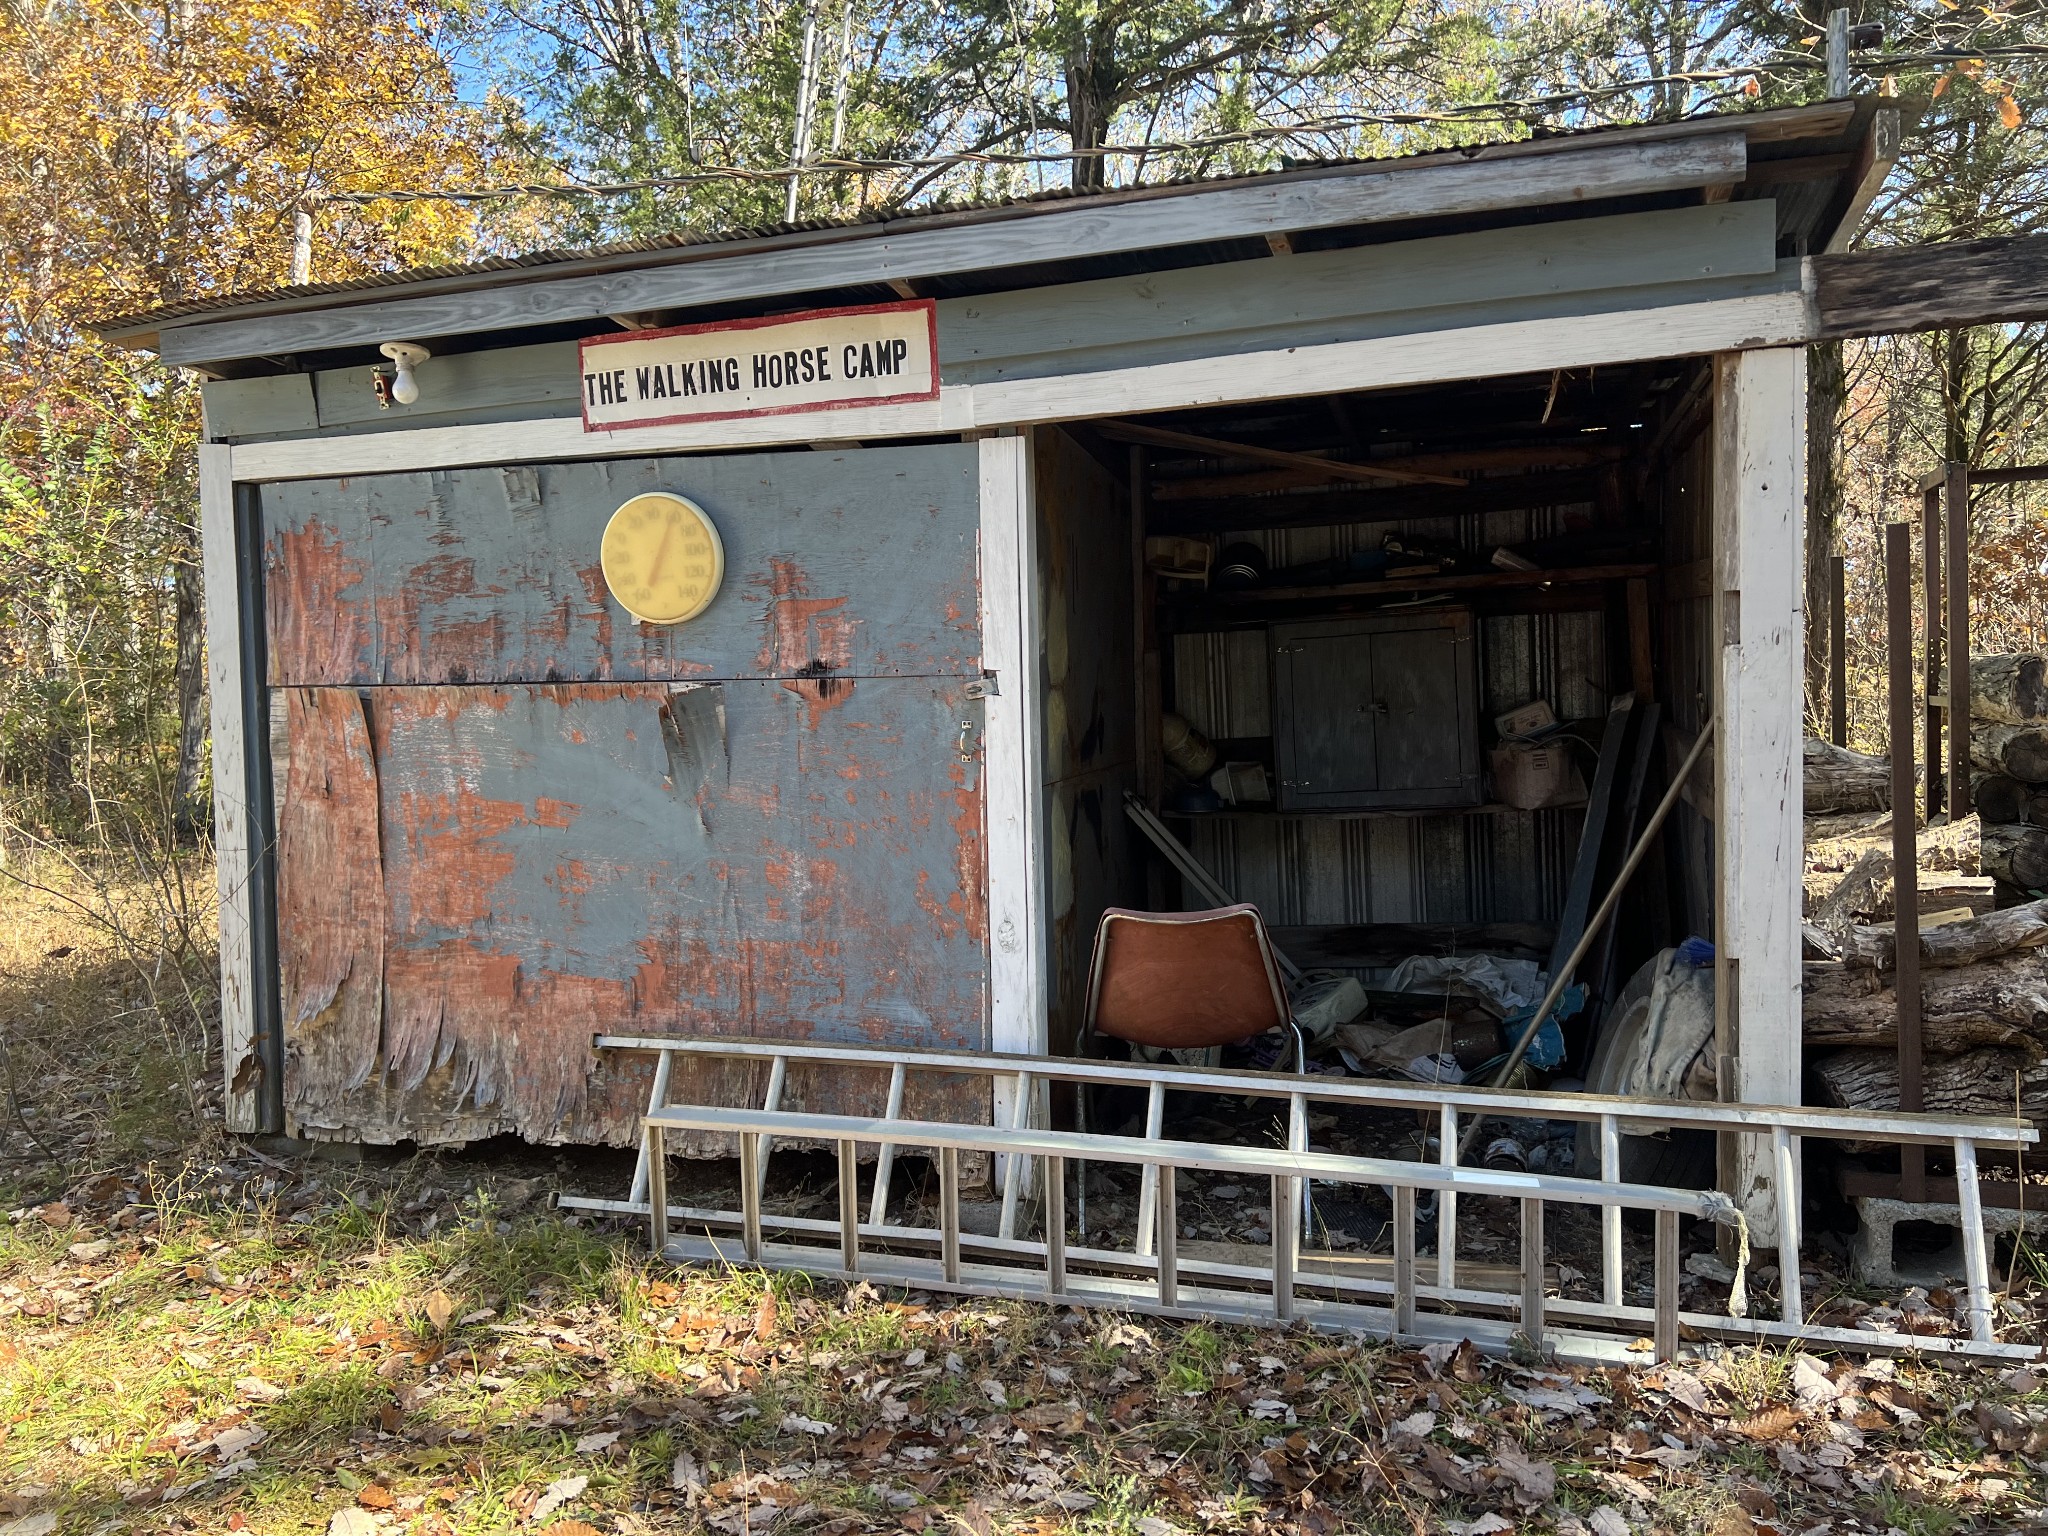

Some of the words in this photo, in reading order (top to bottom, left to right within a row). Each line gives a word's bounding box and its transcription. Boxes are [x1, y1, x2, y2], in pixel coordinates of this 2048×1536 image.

[585, 371, 627, 406] THE
[636, 357, 739, 400] WALKING
[752, 346, 830, 389] HORSE
[844, 339, 907, 379] CAMP
[666, 510, 682, 523] 60
[686, 543, 705, 556] 100
[685, 565, 705, 578] 120
[679, 585, 698, 598] 140
